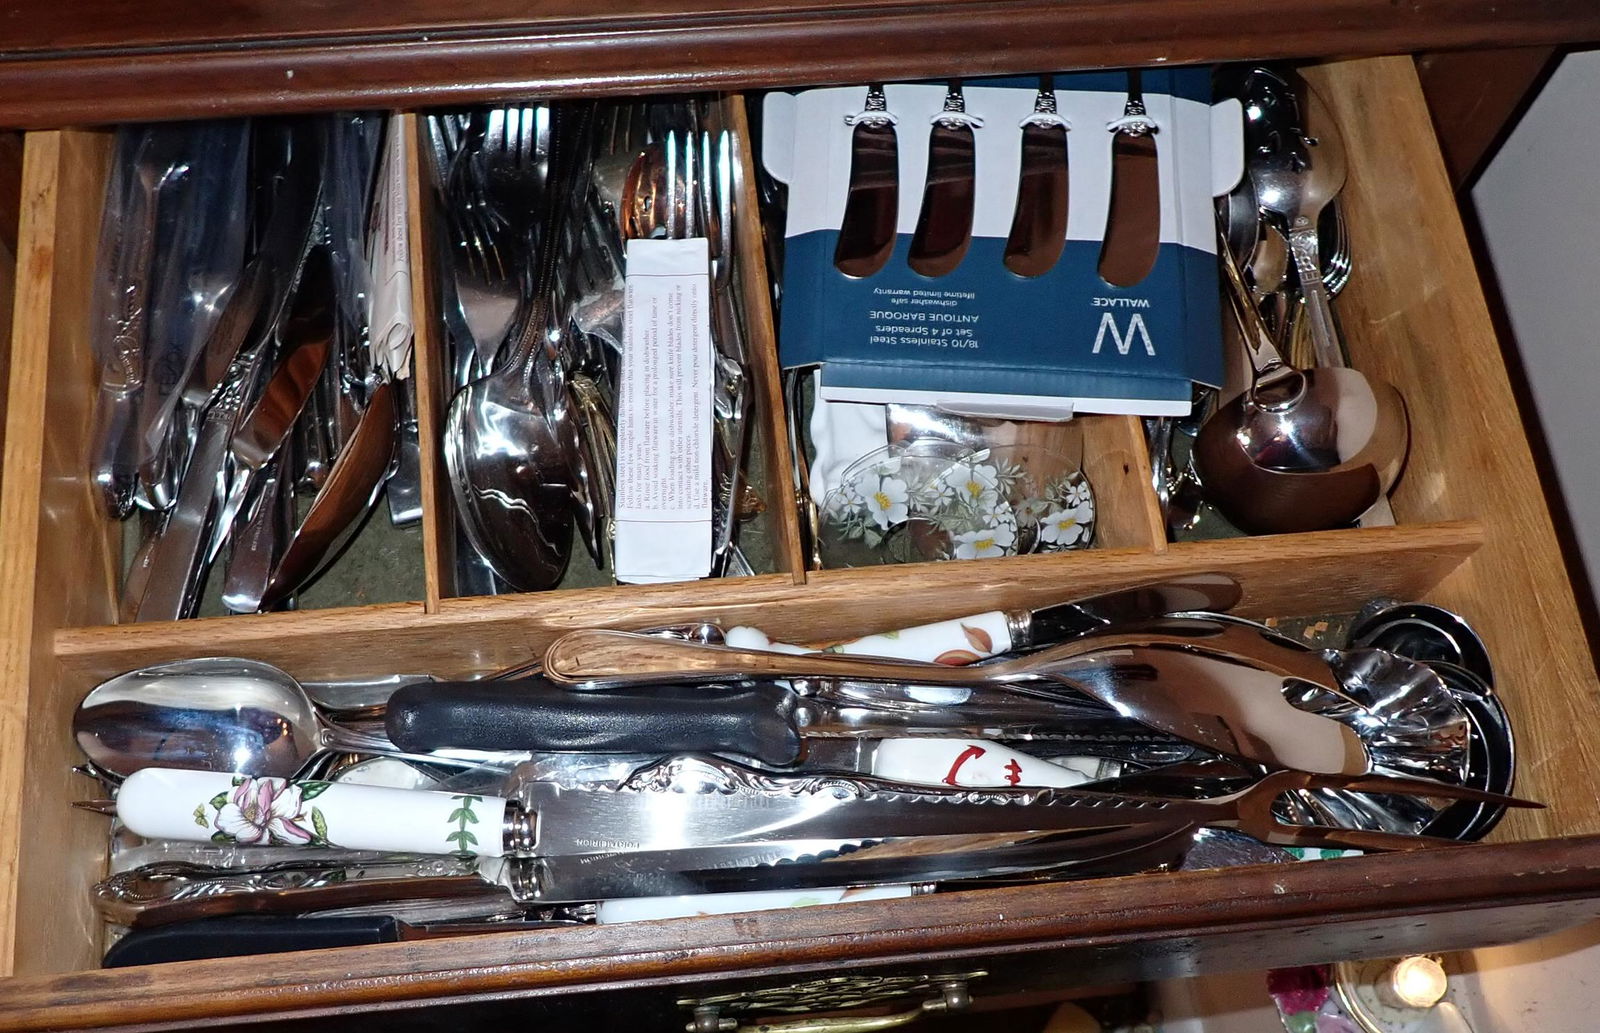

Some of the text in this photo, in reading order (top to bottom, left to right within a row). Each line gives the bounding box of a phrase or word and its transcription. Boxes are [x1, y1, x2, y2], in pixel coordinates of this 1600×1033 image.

[873, 287, 975, 300] lifetime limited warranty
[1092, 297, 1150, 308] WALLACE
[869, 310, 979, 323] ANTIQUE BAROQUE
[875, 325, 973, 337] Set of 4 Spreaders
[1092, 312, 1156, 356] W
[870, 336, 979, 348] 18/10 Stainless Steel
